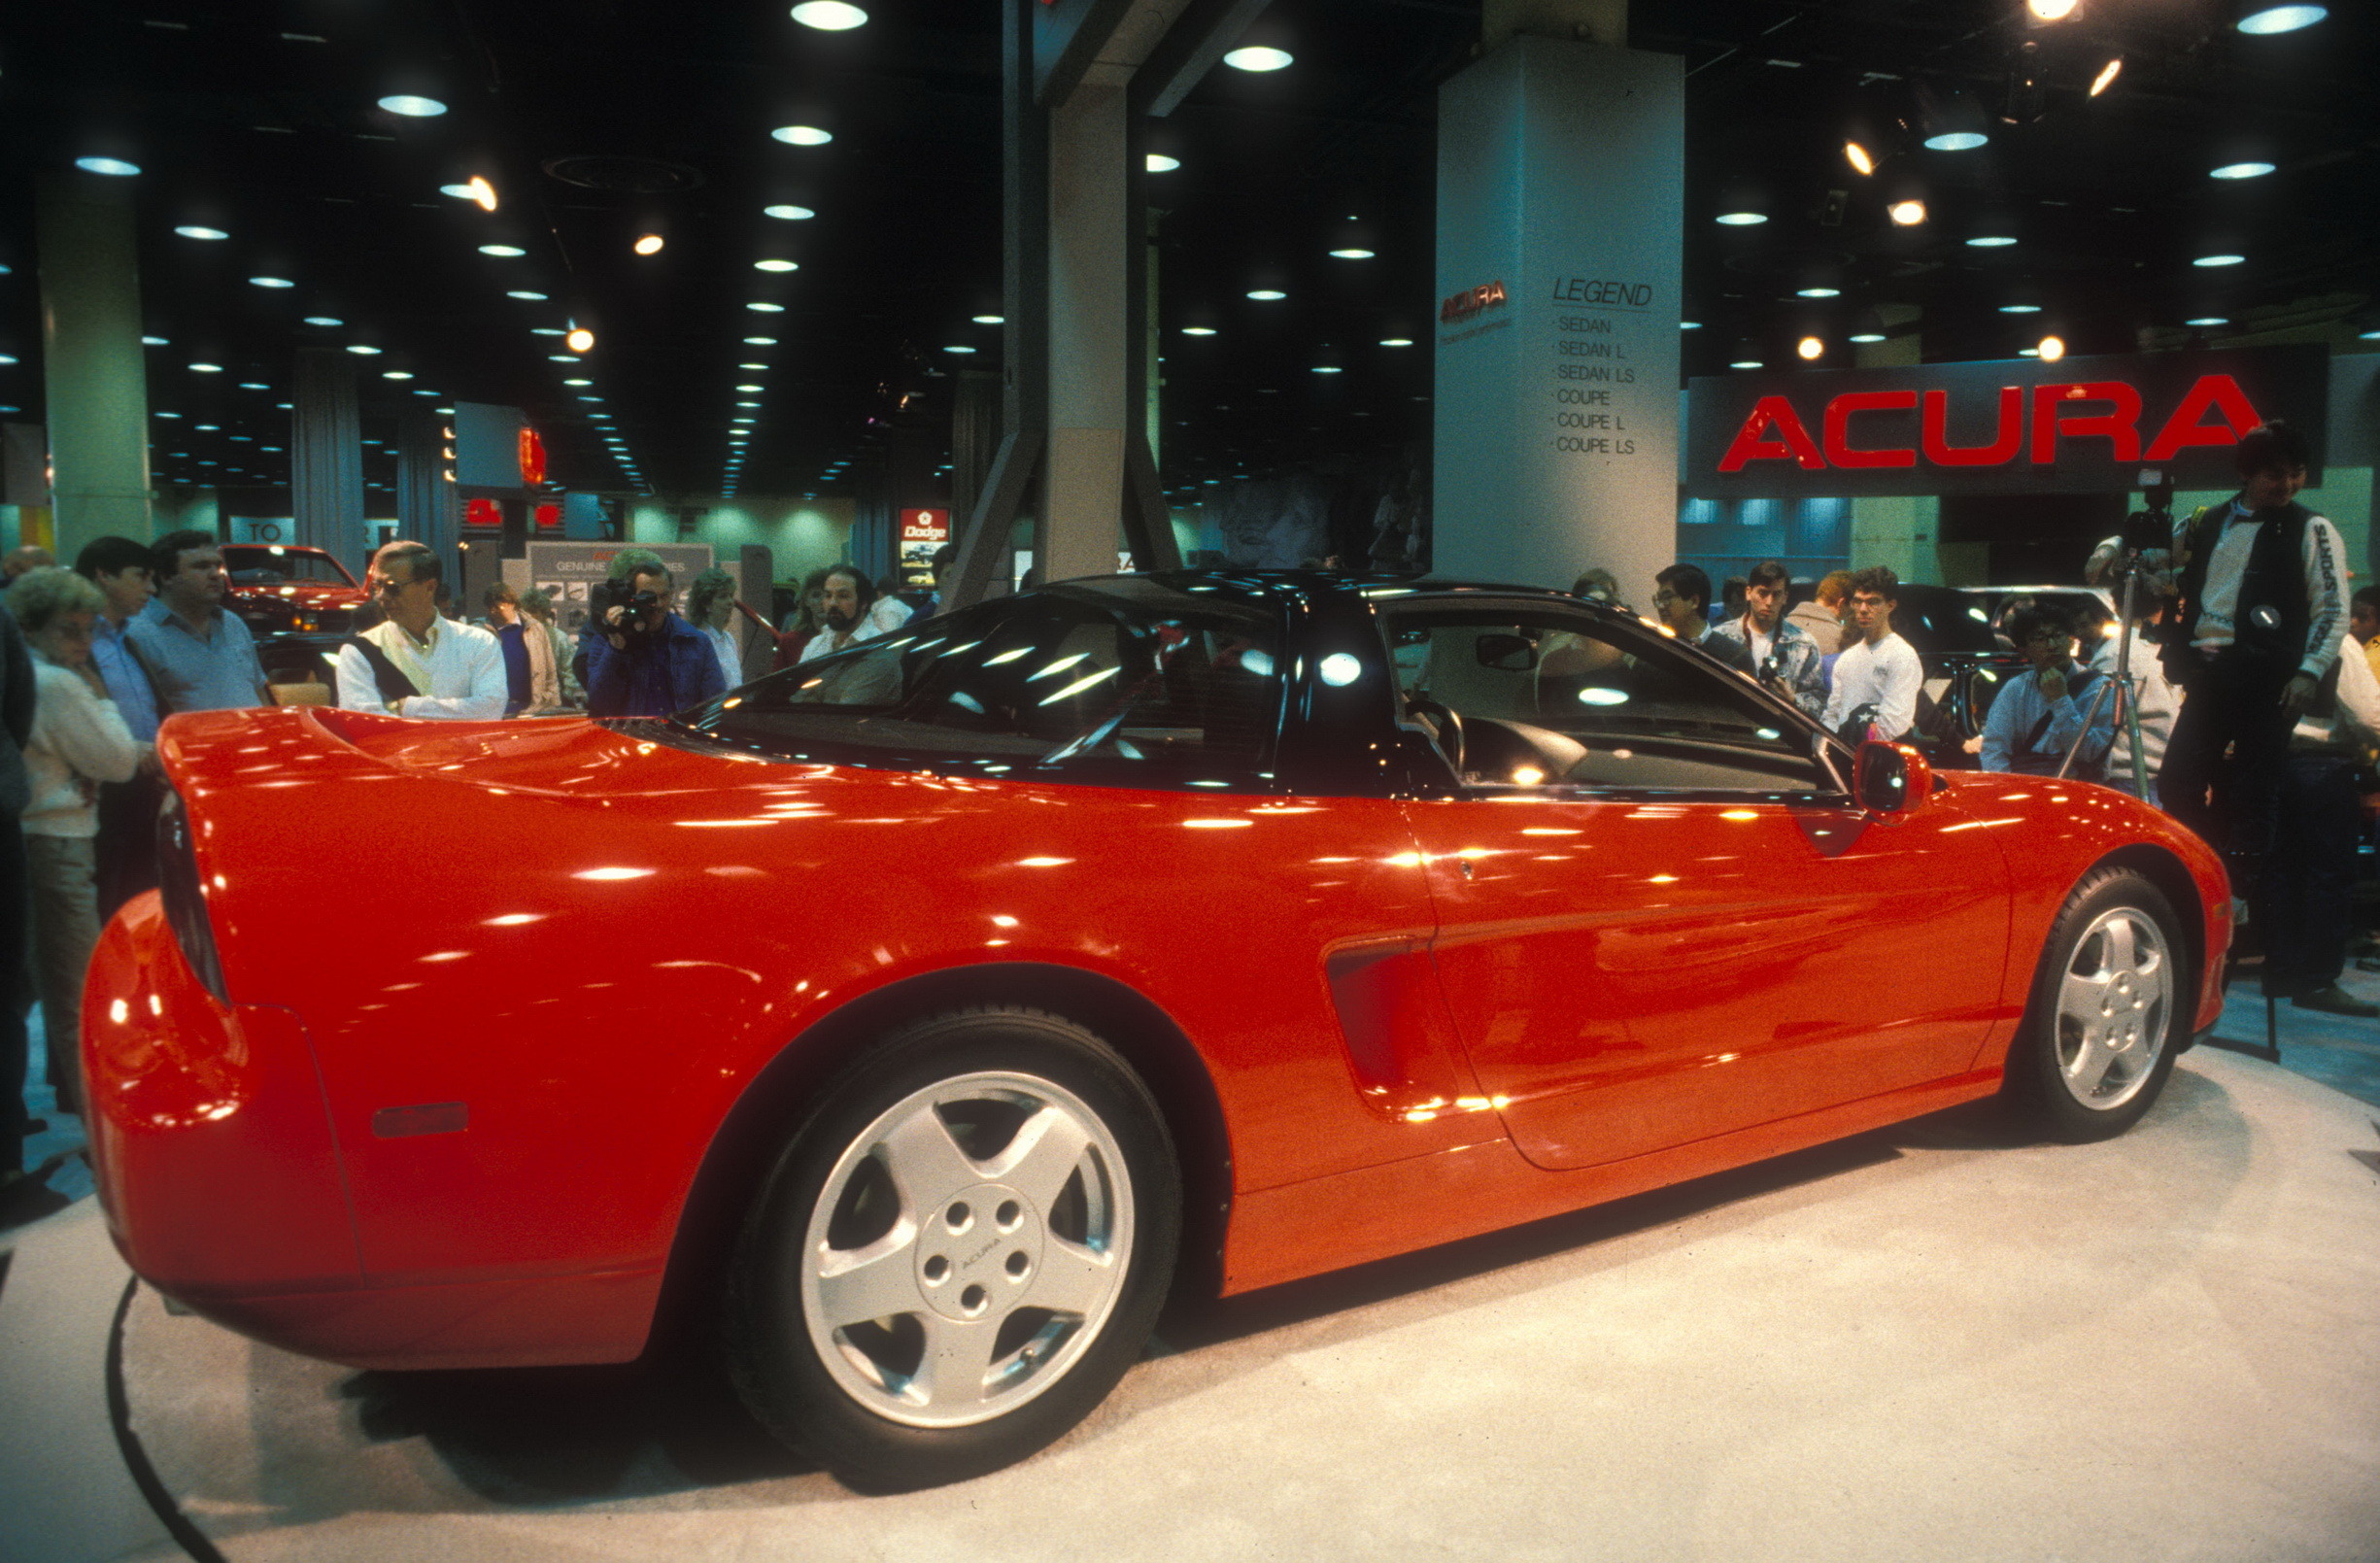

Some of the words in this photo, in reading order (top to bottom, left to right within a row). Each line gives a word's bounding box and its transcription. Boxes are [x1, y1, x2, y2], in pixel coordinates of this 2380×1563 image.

[1552, 277, 1651, 306] LEGEND
[1440, 280, 1507, 323] ACURA
[1558, 317, 1612, 333] SEDAN
[1558, 341, 1611, 357] SEDAN
[1615, 344, 1625, 359] L
[1557, 364, 1611, 382] SEDAN
[1615, 368, 1635, 384] LS
[1557, 389, 1611, 406] COUPE
[1557, 413, 1611, 429] COUPE
[1616, 416, 1625, 430] L
[1717, 374, 2262, 472] ACURA
[1557, 436, 1611, 454] COUPE
[1615, 440, 1635, 455] LS
[904, 526, 946, 540] Dodge
[557, 561, 607, 572] GENUINE
[2315, 524, 2338, 592] SPORTS
